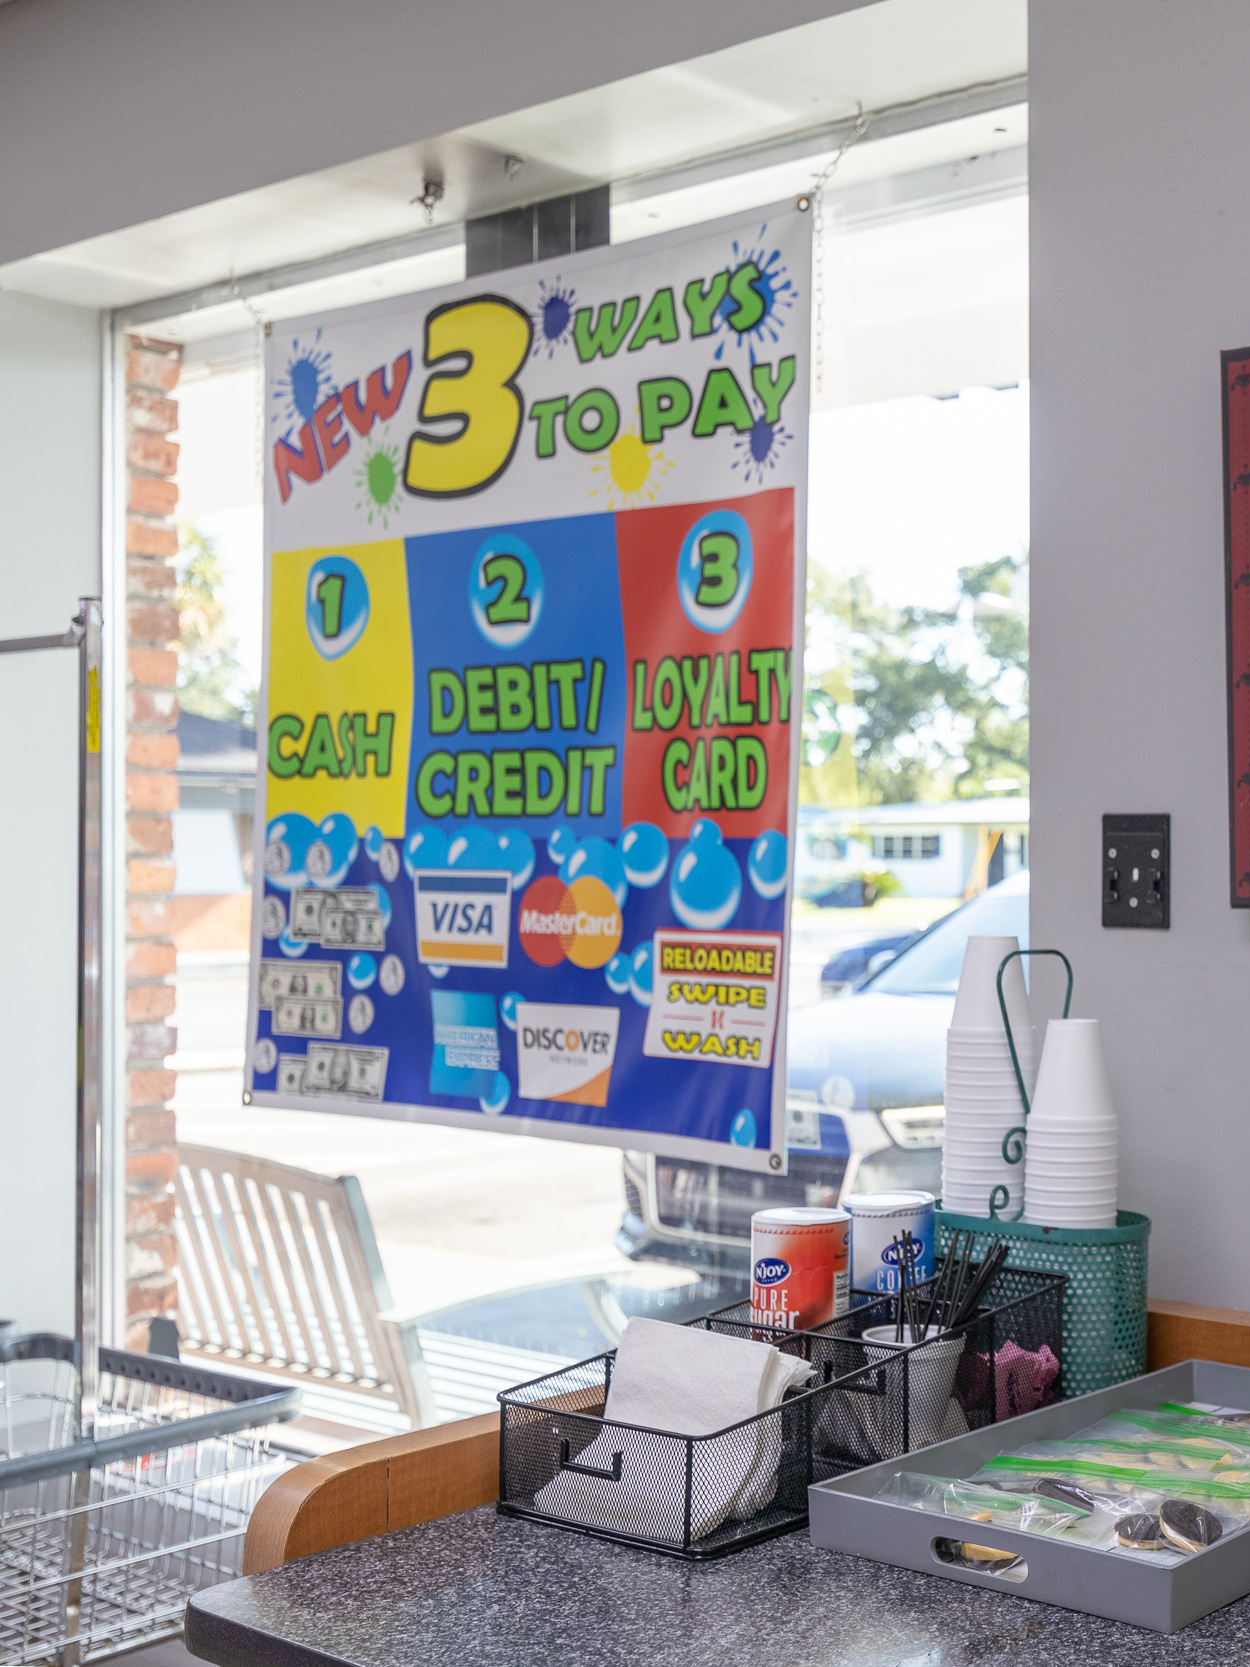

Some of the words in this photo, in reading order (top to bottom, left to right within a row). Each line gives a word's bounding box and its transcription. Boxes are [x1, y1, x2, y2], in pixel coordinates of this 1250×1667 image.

[274, 349, 412, 504] NEW
[403, 293, 532, 501] 3
[573, 261, 766, 363] WAYS
[528, 388, 620, 458] TO
[637, 355, 797, 443] PAY
[482, 554, 531, 625] 2
[695, 531, 740, 608] 3
[316, 572, 346, 639] 1
[428, 657, 605, 735] DEBIT/
[632, 647, 791, 732] LOYALTY
[267, 712, 395, 780] CASH
[662, 734, 768, 813] CARD
[415, 745, 616, 818] CREDIT
[430, 902, 494, 935] VISA
[662, 946, 774, 975] RELOADABLE
[667, 981, 766, 1009] SWIPE
[522, 1027, 611, 1056] DISCOVER
[662, 1030, 761, 1060] WASH
[753, 1286, 788, 1311] PURE
